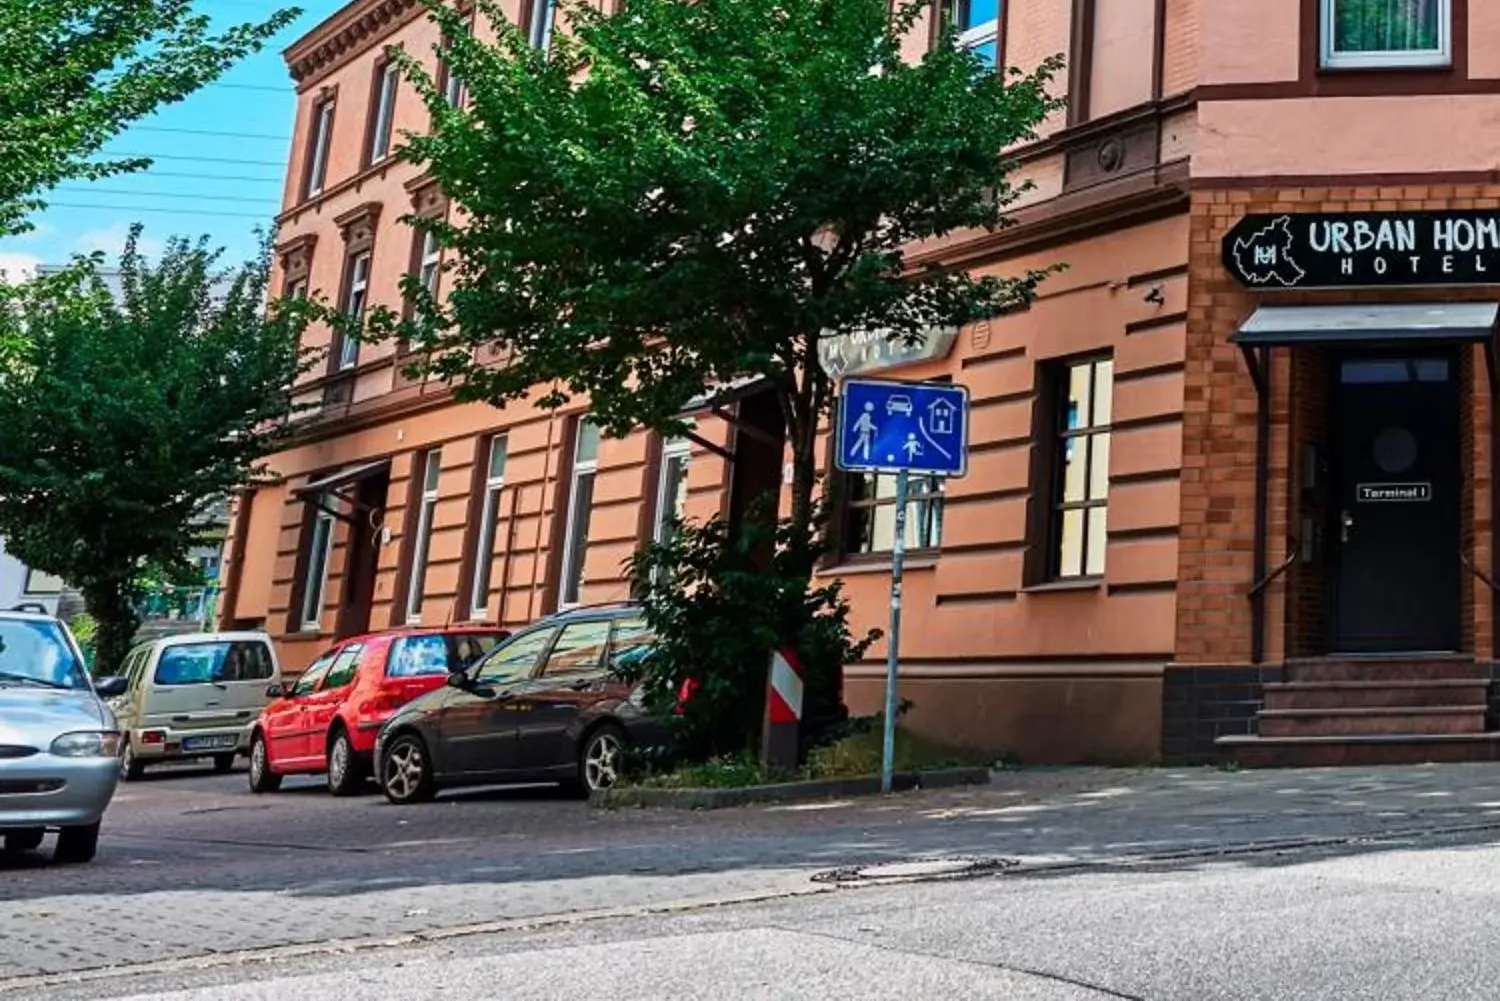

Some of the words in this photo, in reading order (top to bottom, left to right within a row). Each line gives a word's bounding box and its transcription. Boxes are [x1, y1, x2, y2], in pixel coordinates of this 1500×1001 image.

[1308, 218, 1415, 253] URBAN
[1341, 255, 1487, 276] HOTEL
[1363, 486, 1417, 498] Terminal
